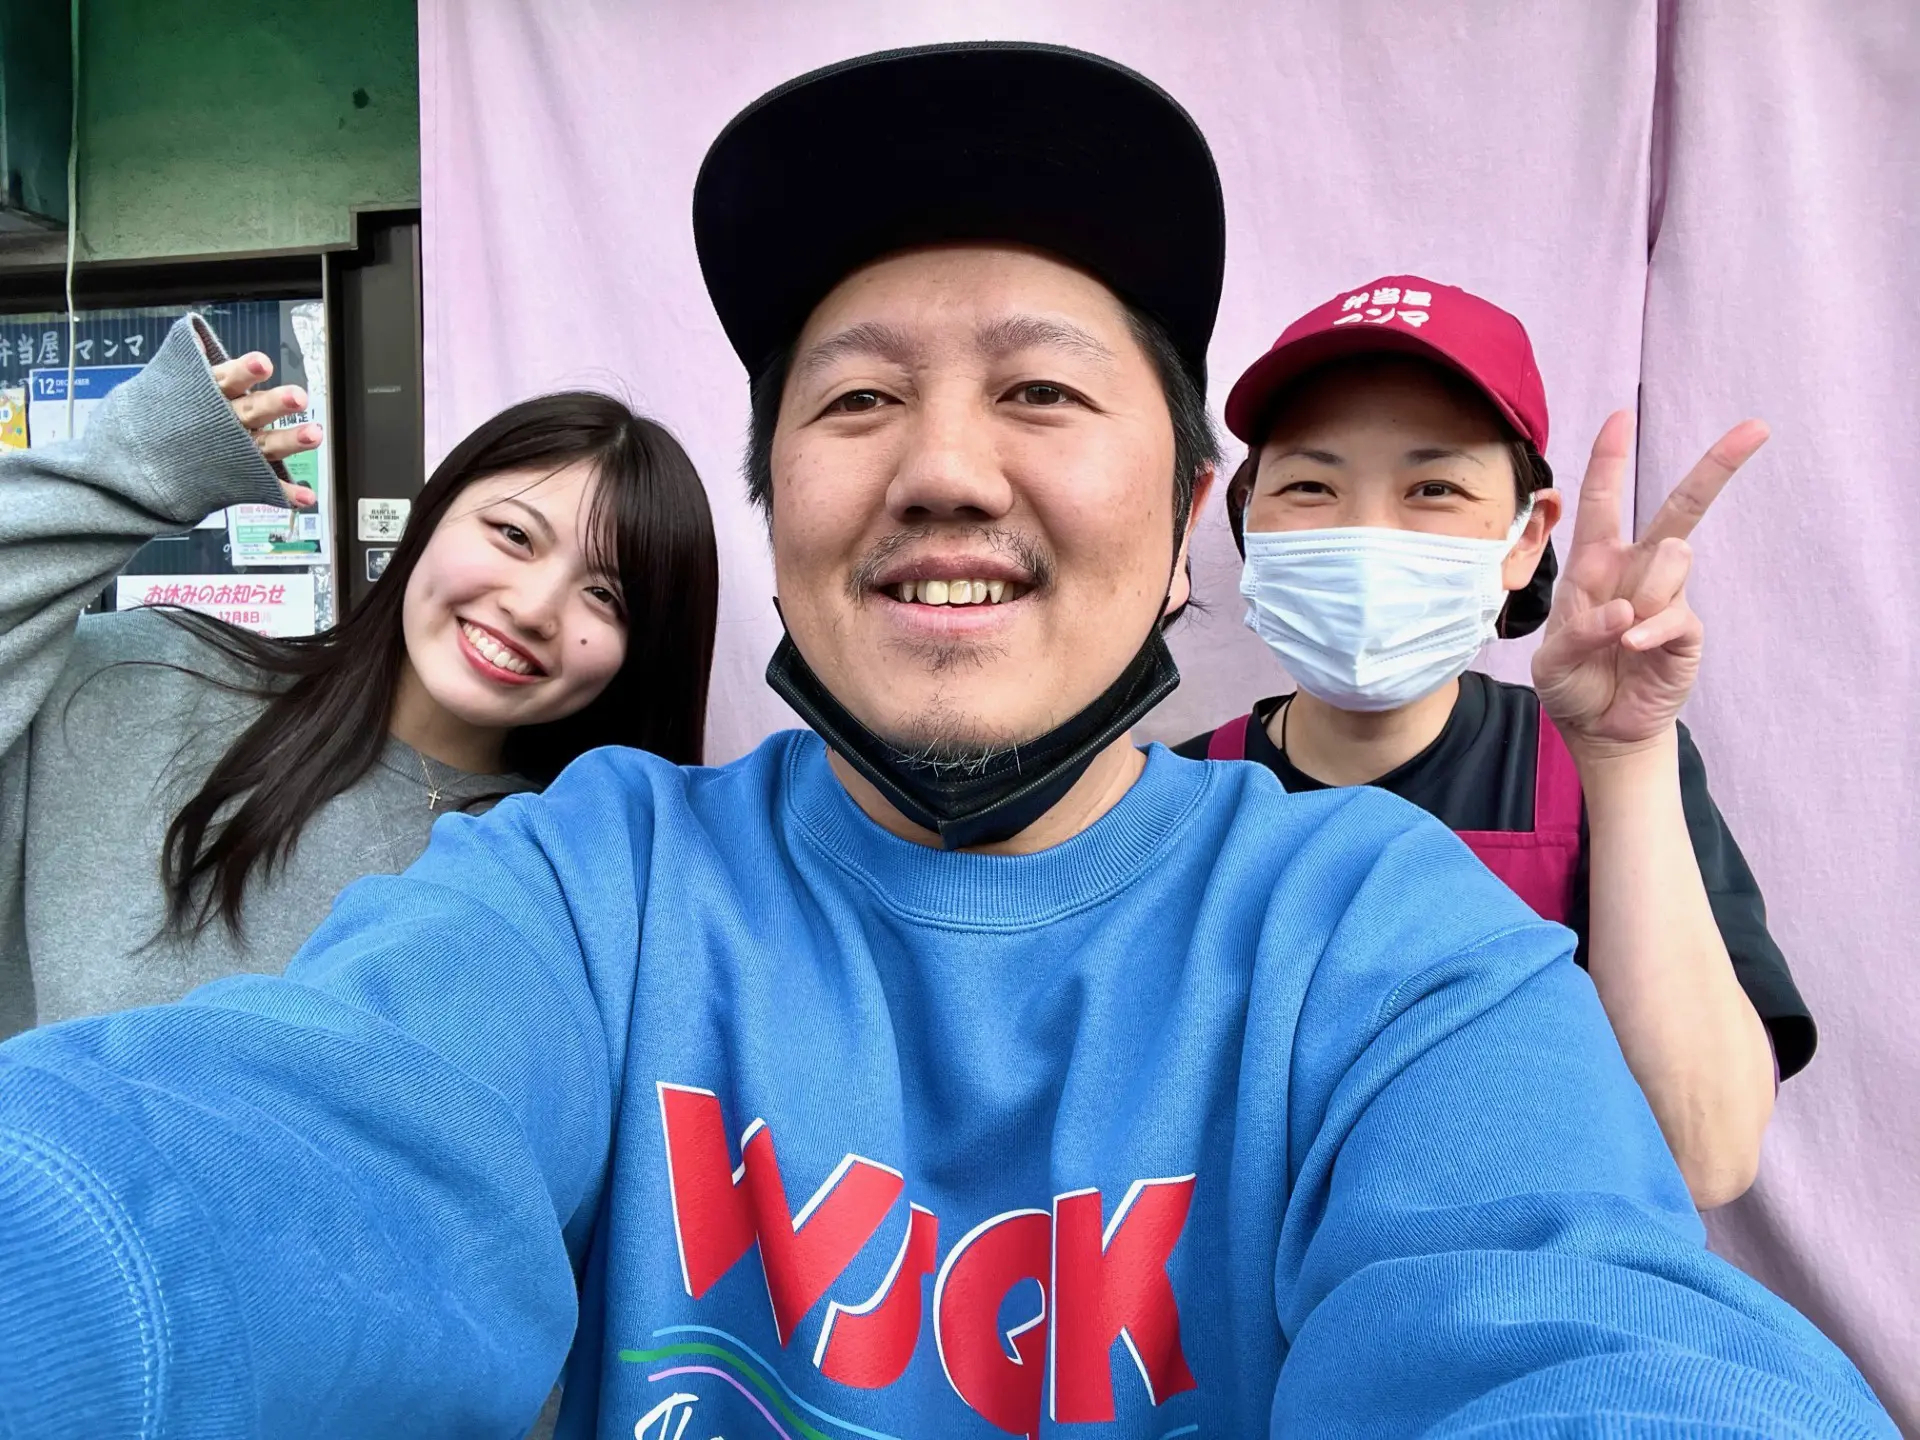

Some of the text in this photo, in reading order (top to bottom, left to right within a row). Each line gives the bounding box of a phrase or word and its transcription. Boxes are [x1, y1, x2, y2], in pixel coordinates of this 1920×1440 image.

[75, 335, 144, 360] マンマ
[38, 377, 55, 395] 12
[144, 583, 286, 605] お休みのお知らせ
